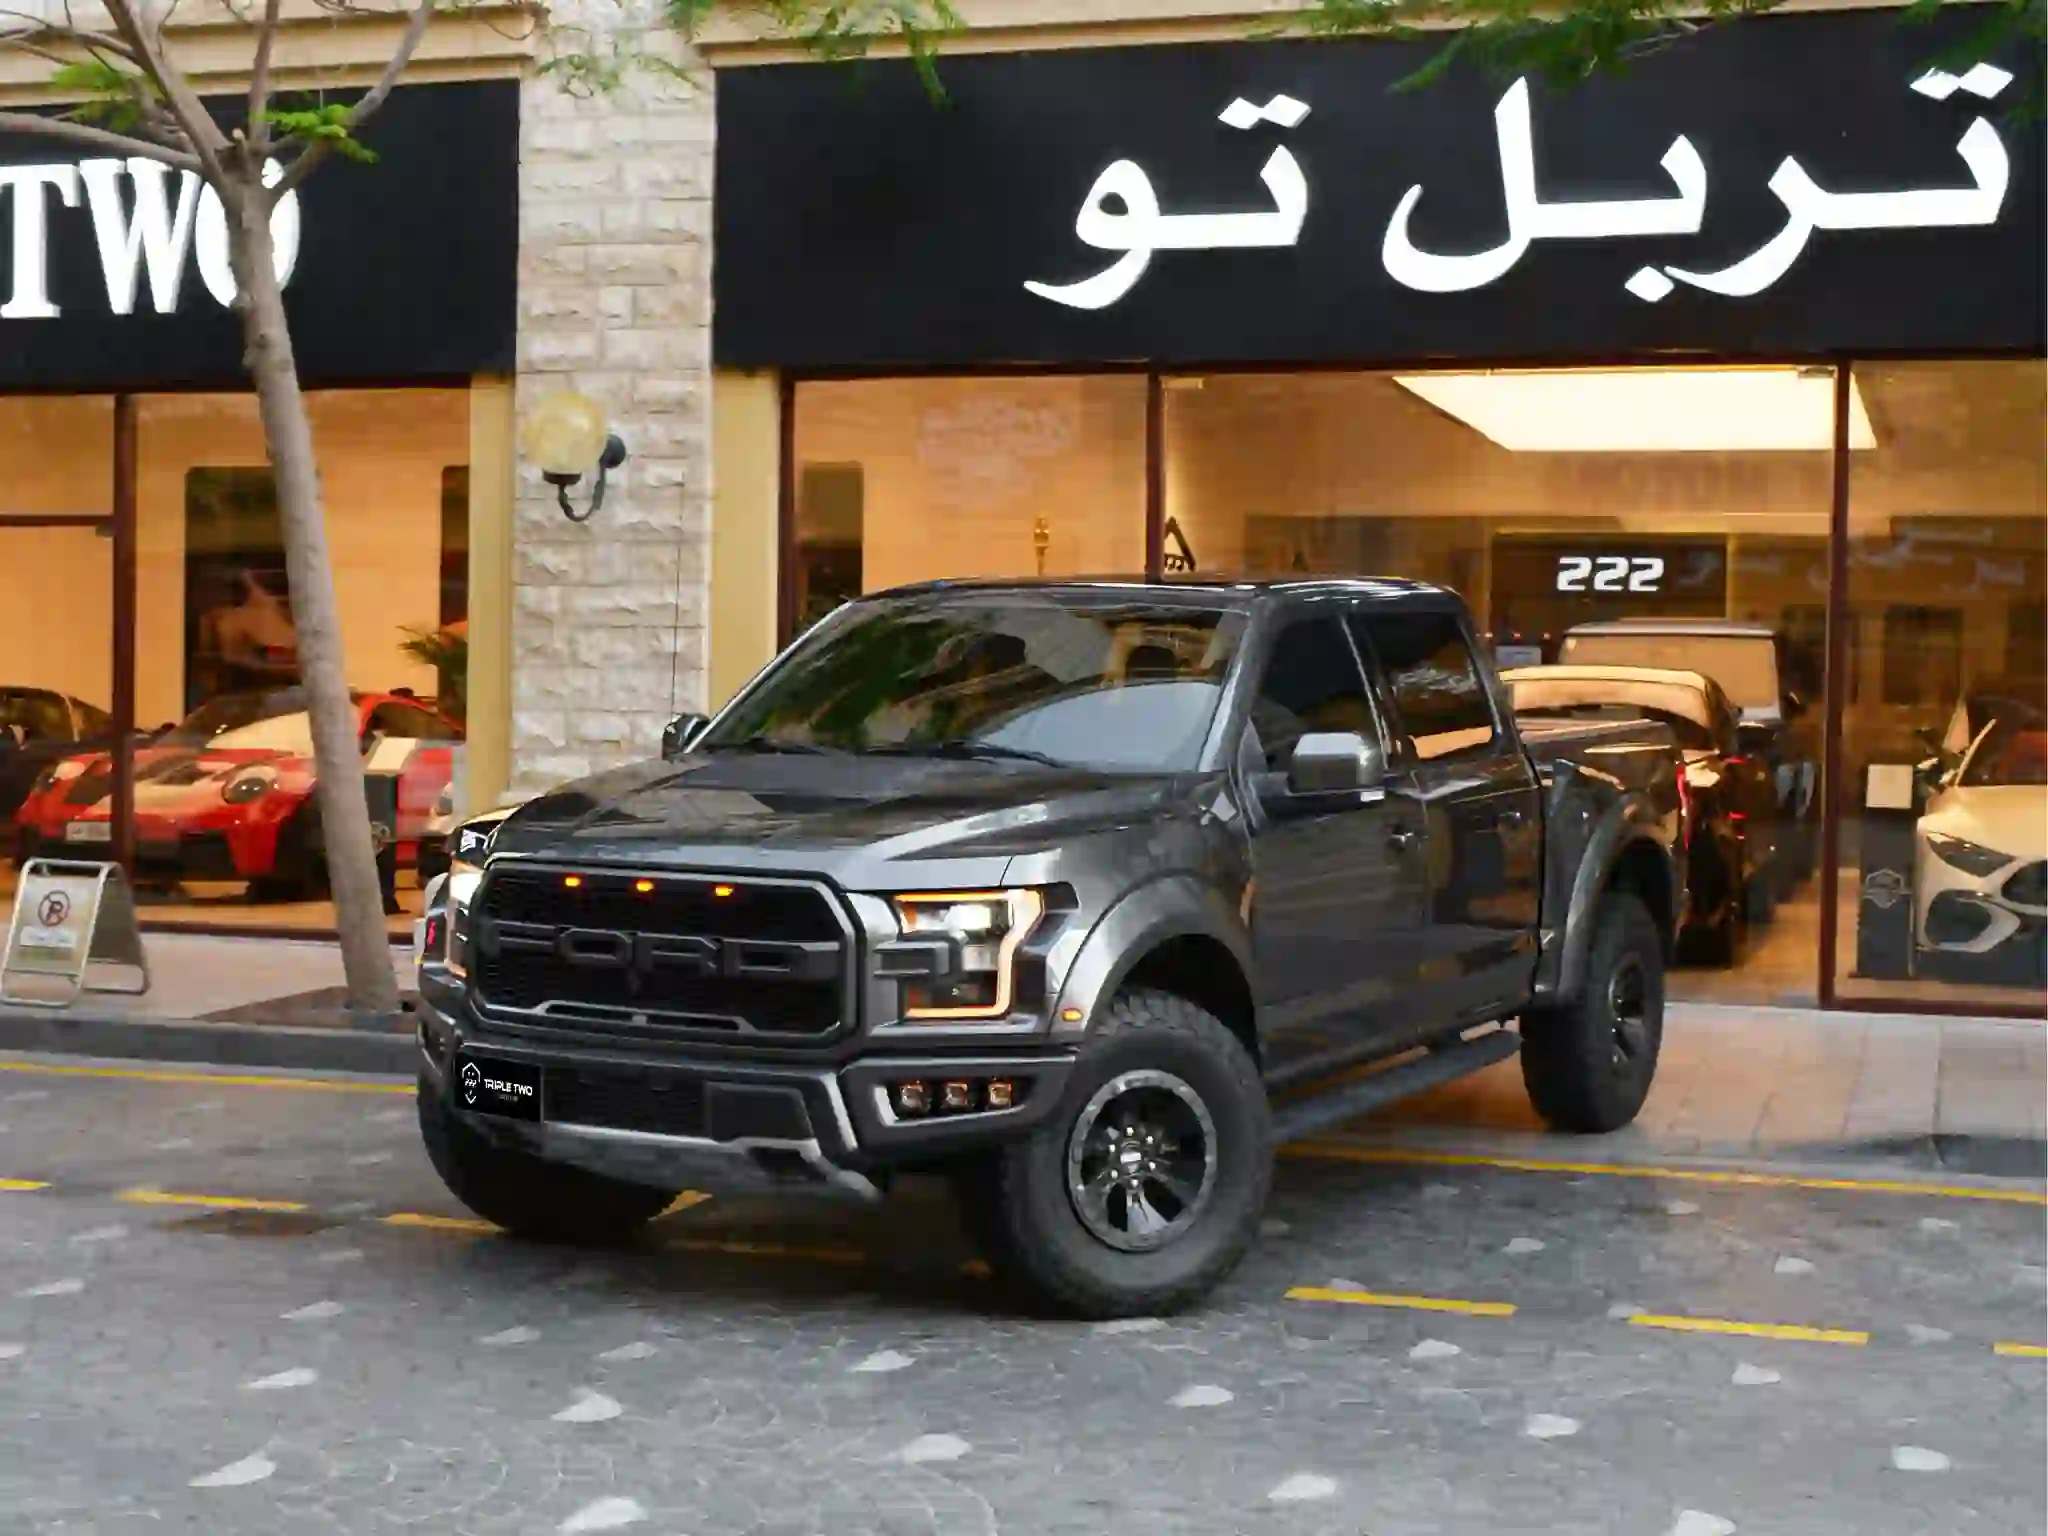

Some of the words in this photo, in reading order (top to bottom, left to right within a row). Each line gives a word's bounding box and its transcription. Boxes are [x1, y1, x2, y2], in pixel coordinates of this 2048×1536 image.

[1023, 93, 1312, 310] تو
[1382, 62, 2014, 302] تربل
[1557, 556, 1665, 592] 222
[478, 919, 841, 982] FORD
[483, 1078, 512, 1093] TRIPLE
[513, 1083, 533, 1097] TWO
